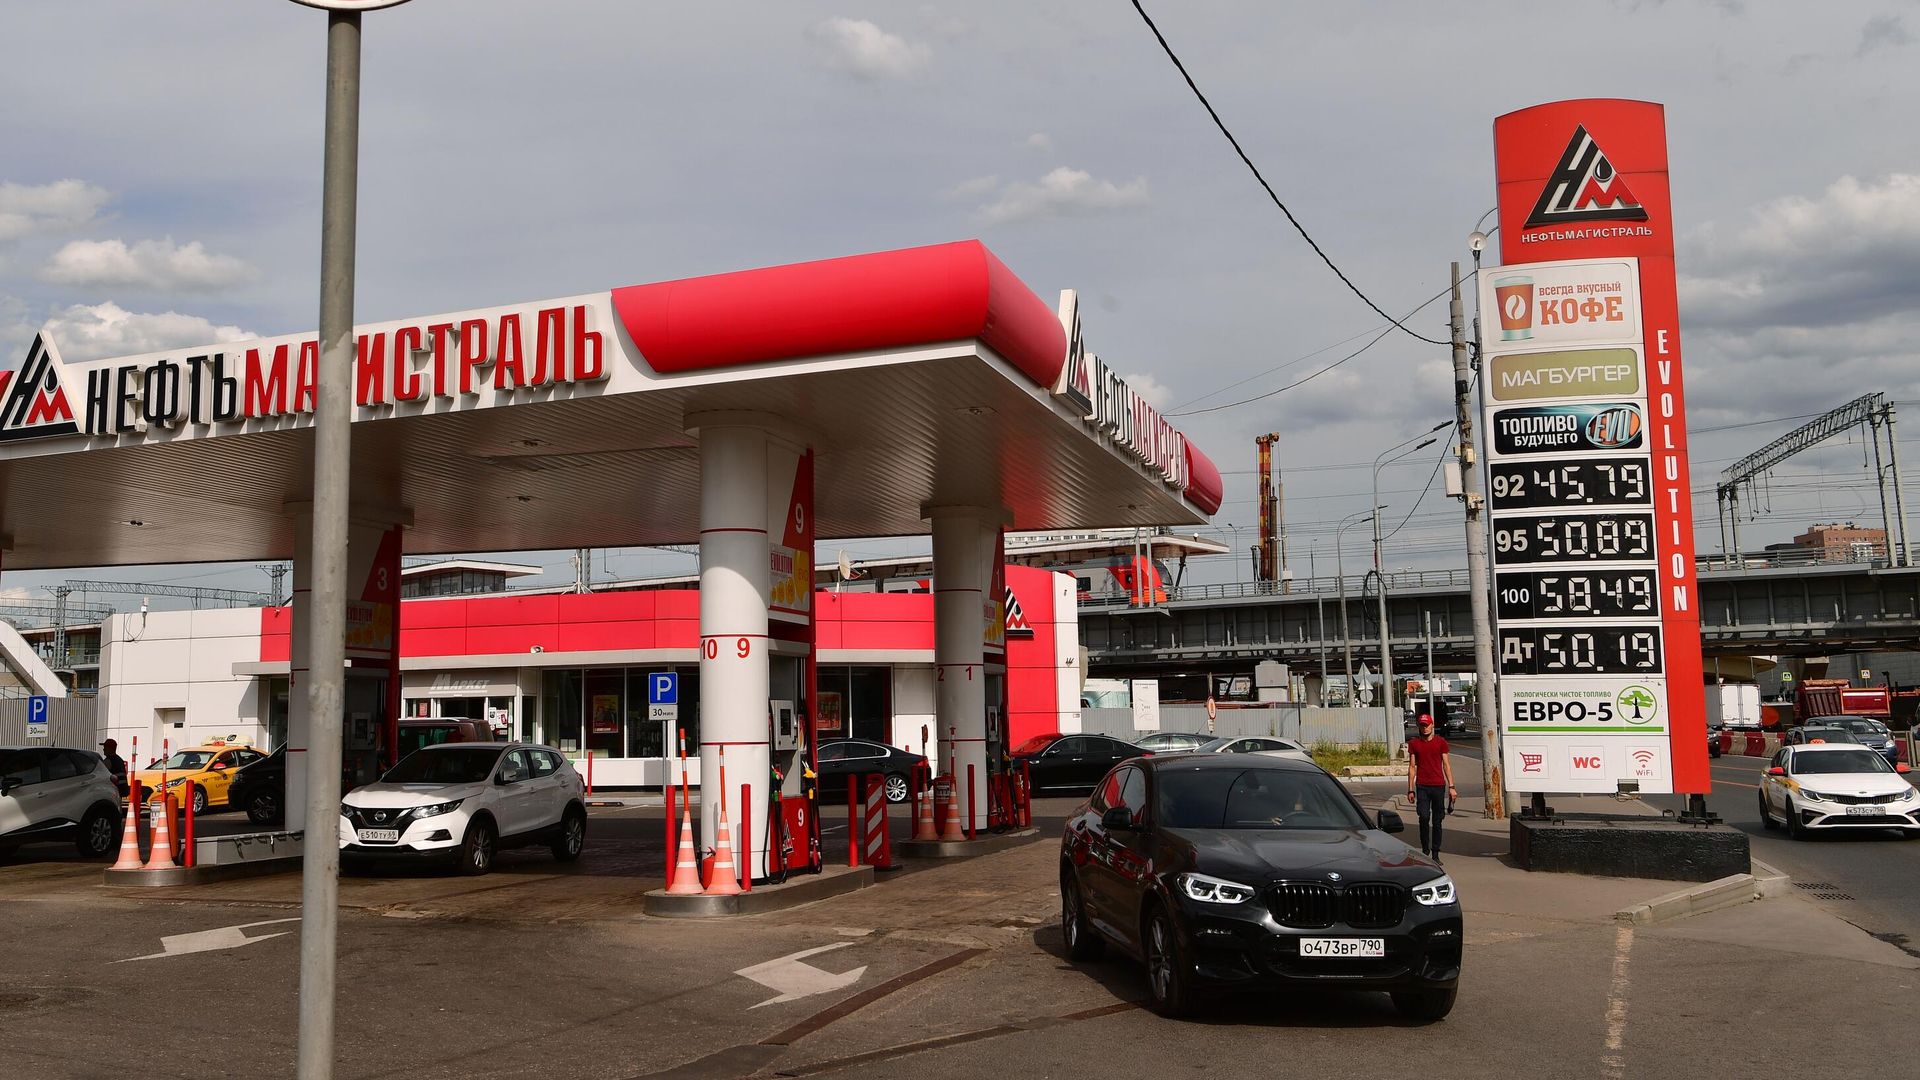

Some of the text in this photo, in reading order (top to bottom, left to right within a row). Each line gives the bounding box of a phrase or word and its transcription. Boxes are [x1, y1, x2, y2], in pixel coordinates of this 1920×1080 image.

[1521, 227, 1653, 243] НЕФТЬМАГИСТРАЛЬ
[1539, 281, 1622, 296] всегда вкусный
[1539, 296, 1624, 326] КОФЕ
[86, 305, 605, 435] НЕФТЬМАИСТРАЛЬ
[1502, 365, 1631, 388] МАГБУРГЕР
[1500, 415, 1578, 435] ТОПЛИВО
[1593, 410, 1631, 442] EVO
[1514, 433, 1578, 447] БУДУЩЕГО
[1656, 329, 1688, 612] EVOLUTION
[1493, 464, 1643, 503] 92 45.79
[795, 503, 804, 534] 9
[1495, 520, 1647, 559] 95 50.89
[377, 567, 388, 591] 3
[1500, 576, 1651, 615] 100 58.49
[700, 639, 718, 660] 10
[737, 637, 751, 659] 9
[1543, 633, 1655, 671] 50.19
[937, 667, 945, 681] 2
[965, 666, 972, 680] 1
[656, 676, 673, 701] P
[33, 698, 45, 721] P
[1513, 701, 1613, 722] ЕВРО-5
[1572, 756, 1601, 769] WC
[1635, 769, 1654, 777] WiFi
[797, 808, 804, 827] 9
[1360, 939, 1381, 951] 790
